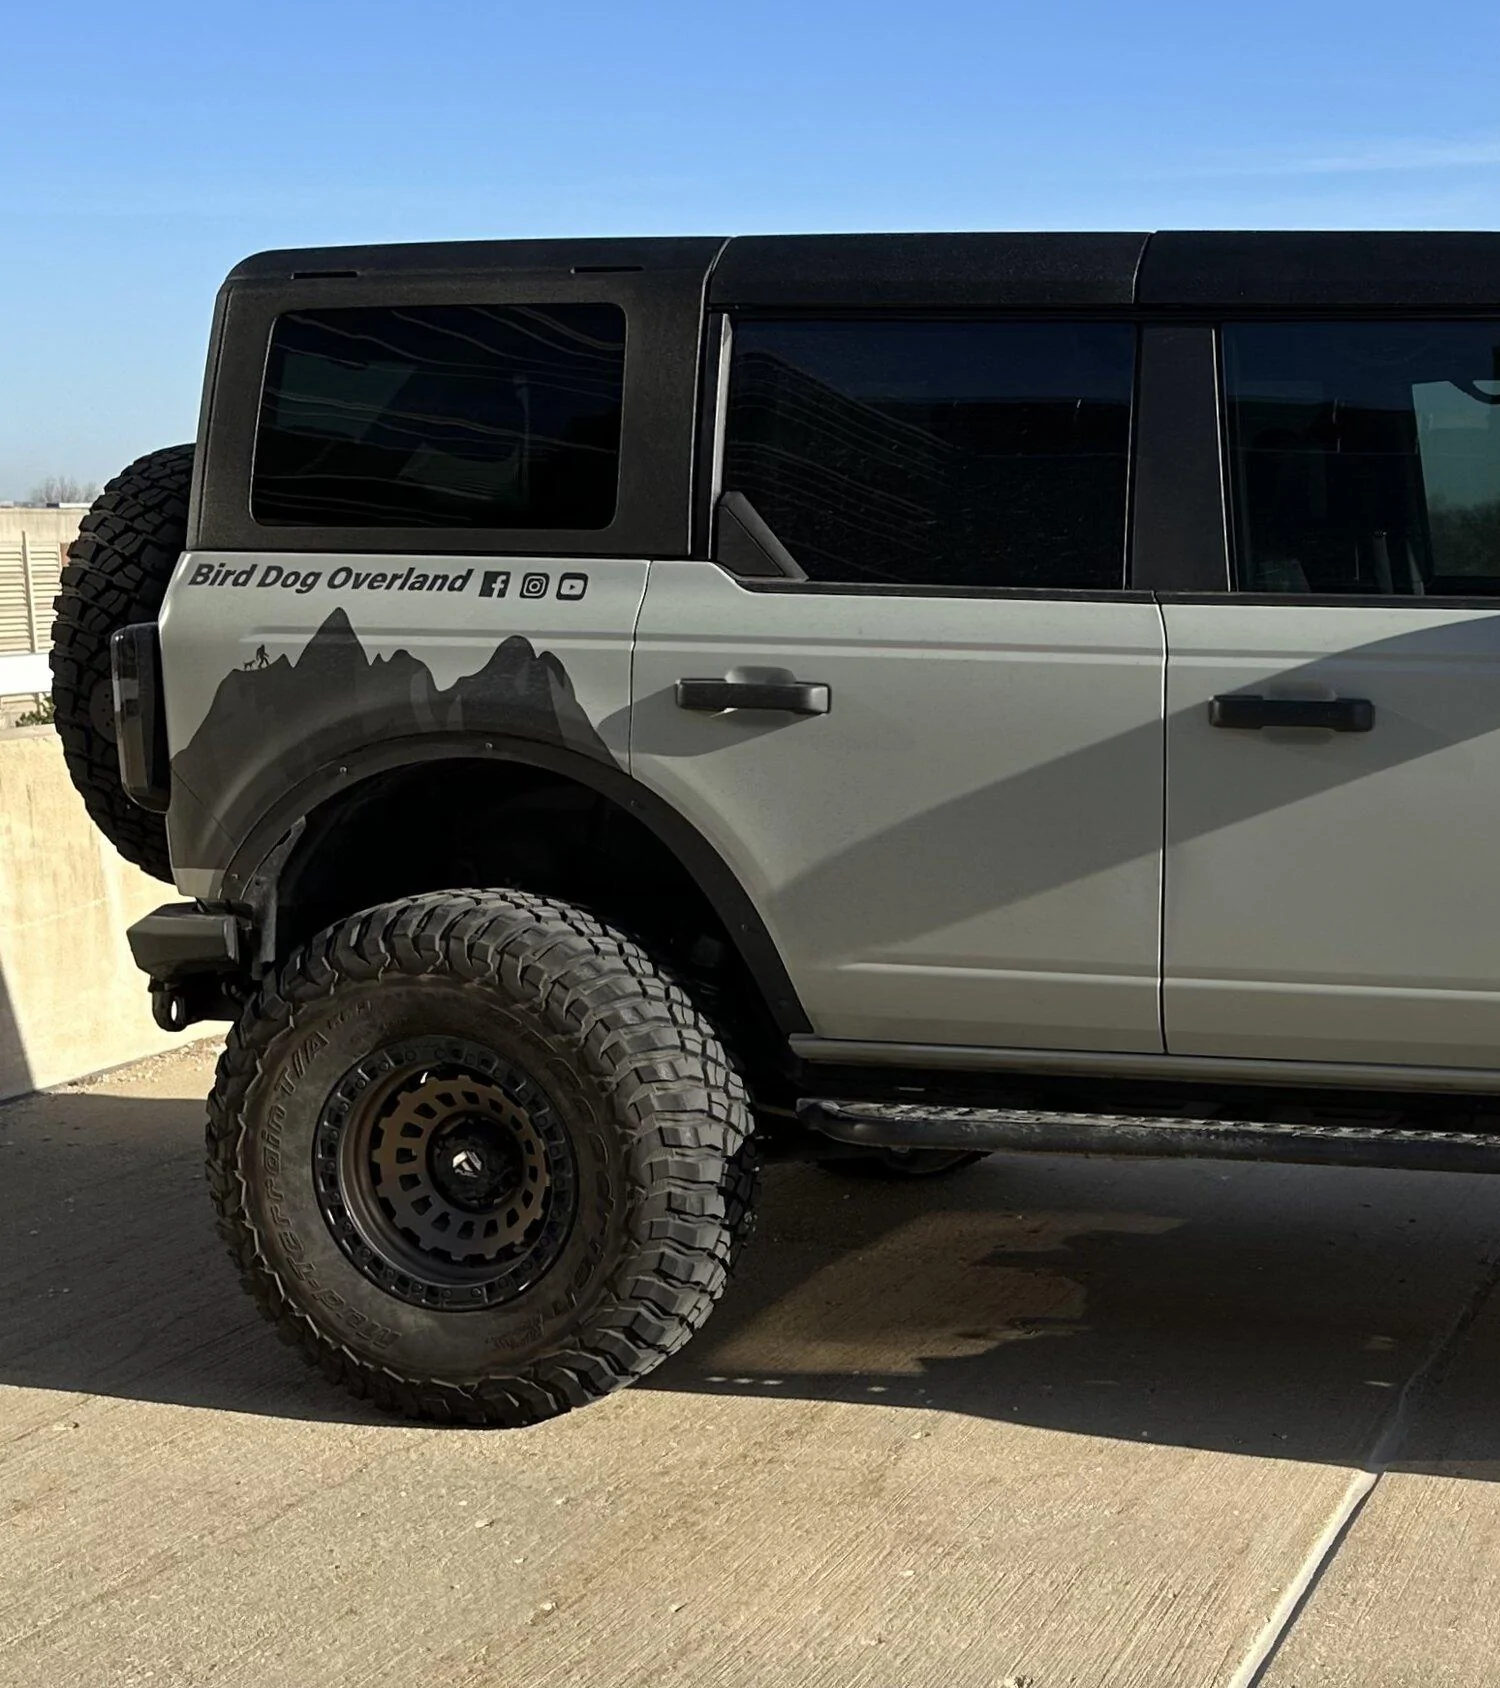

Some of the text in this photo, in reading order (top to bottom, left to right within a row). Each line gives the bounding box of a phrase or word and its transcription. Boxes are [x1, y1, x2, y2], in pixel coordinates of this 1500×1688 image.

[189, 563, 474, 594] Bird Dog Overland
[274, 1030, 330, 1096] T/A
